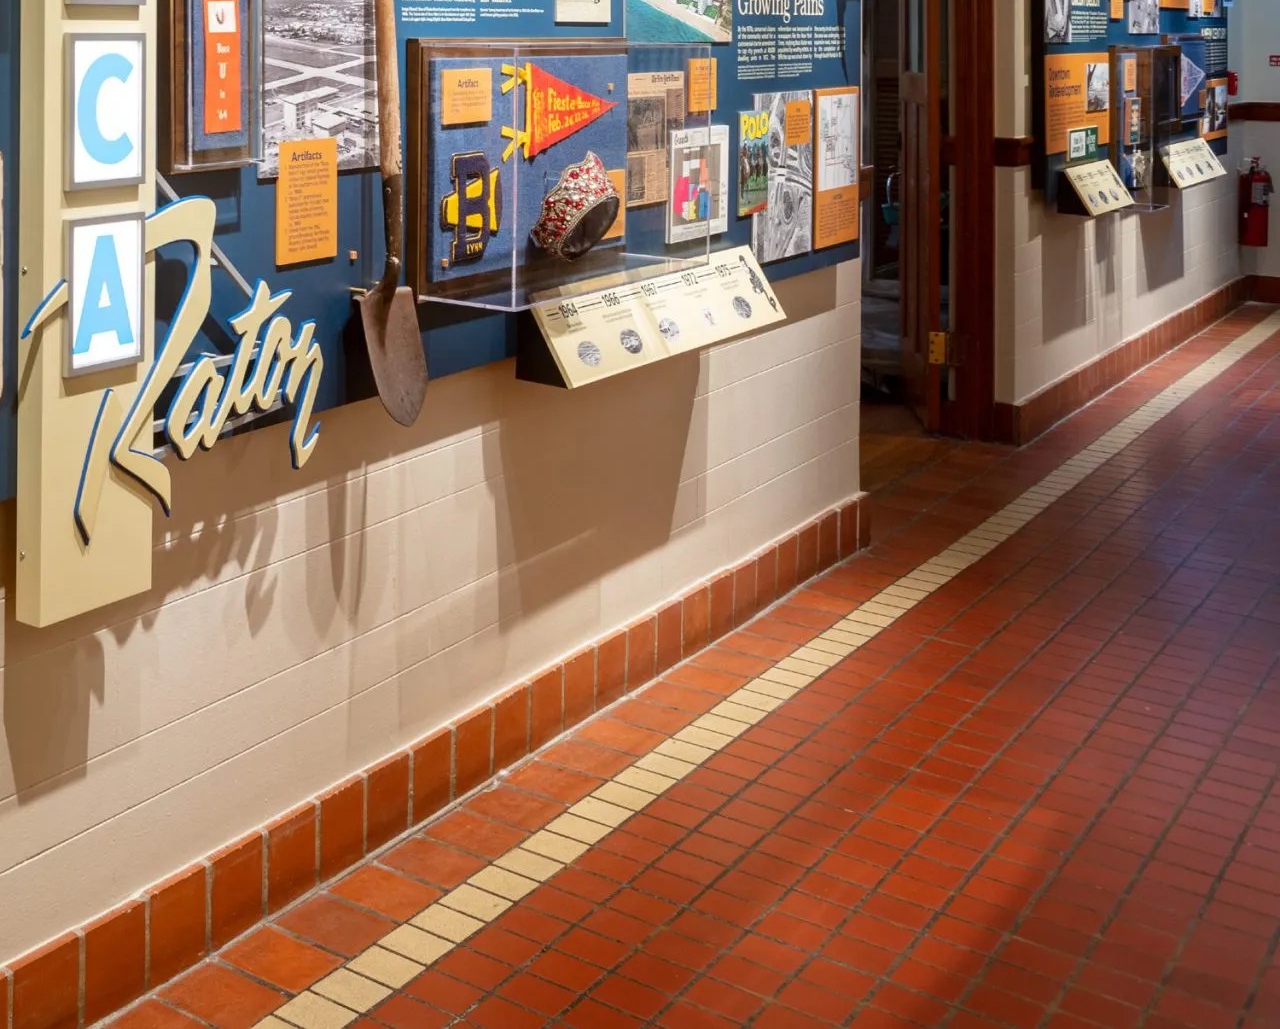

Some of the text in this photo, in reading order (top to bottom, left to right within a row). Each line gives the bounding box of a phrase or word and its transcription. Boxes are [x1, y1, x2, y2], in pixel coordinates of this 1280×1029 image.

[458, 78, 478, 89] Artifact
[741, 112, 769, 141] POLO
[292, 150, 322, 162] Artifacts
[640, 282, 658, 298] 1967
[601, 292, 620, 308] 1966
[558, 303, 578, 319] 1964
[21, 194, 323, 546] Raton
